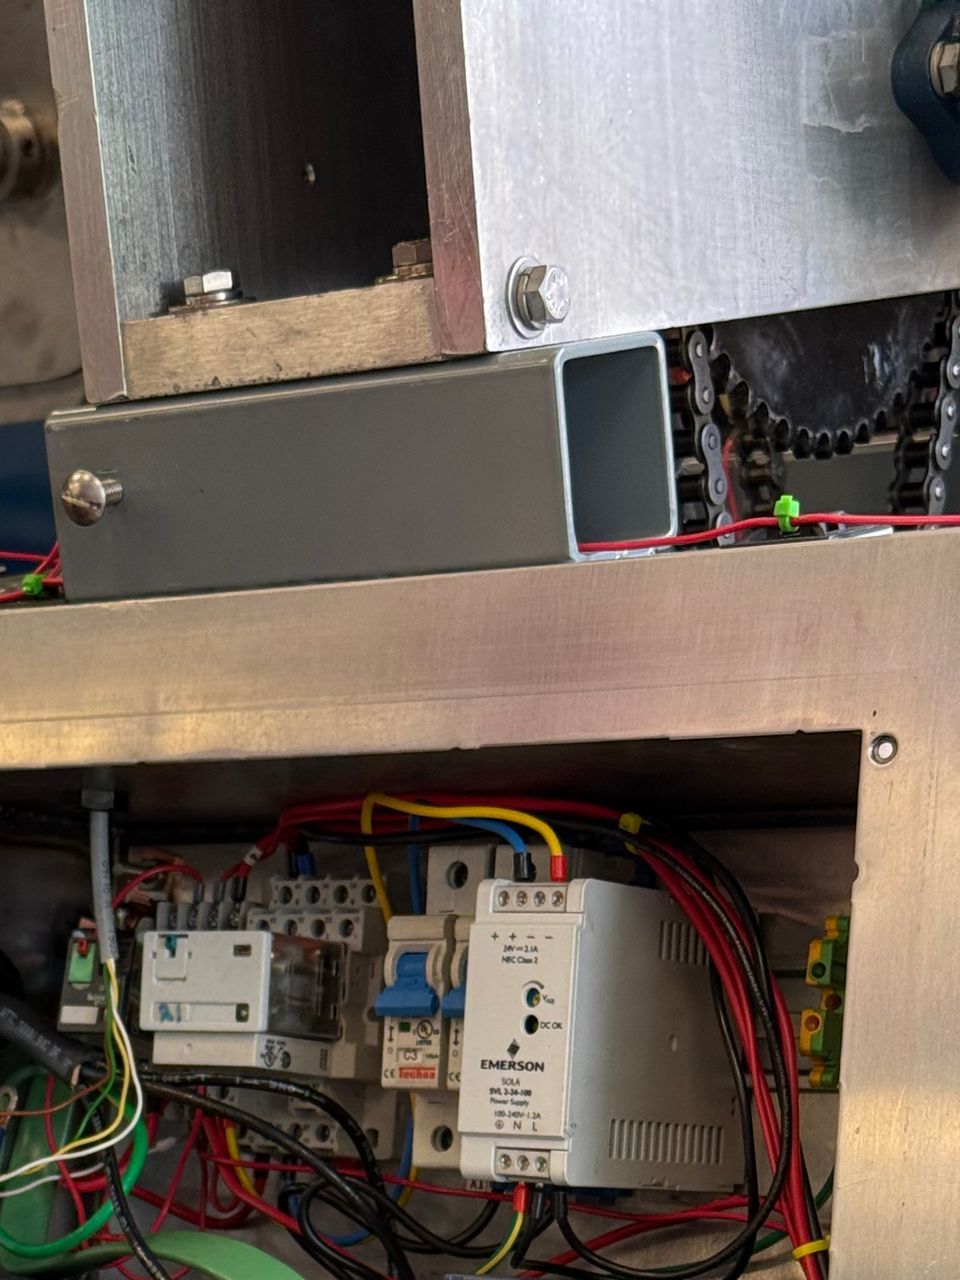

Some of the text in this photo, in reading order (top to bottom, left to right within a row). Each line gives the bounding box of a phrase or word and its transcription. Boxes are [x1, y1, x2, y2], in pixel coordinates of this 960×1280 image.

[501, 956, 516, 964] NEC
[517, 956, 533, 965] Class
[480, 1059, 545, 1073] EMERSON
[501, 1077, 520, 1087] SOLA
[490, 1097, 530, 1108] Power Supply
[512, 1120, 539, 1132] N L
